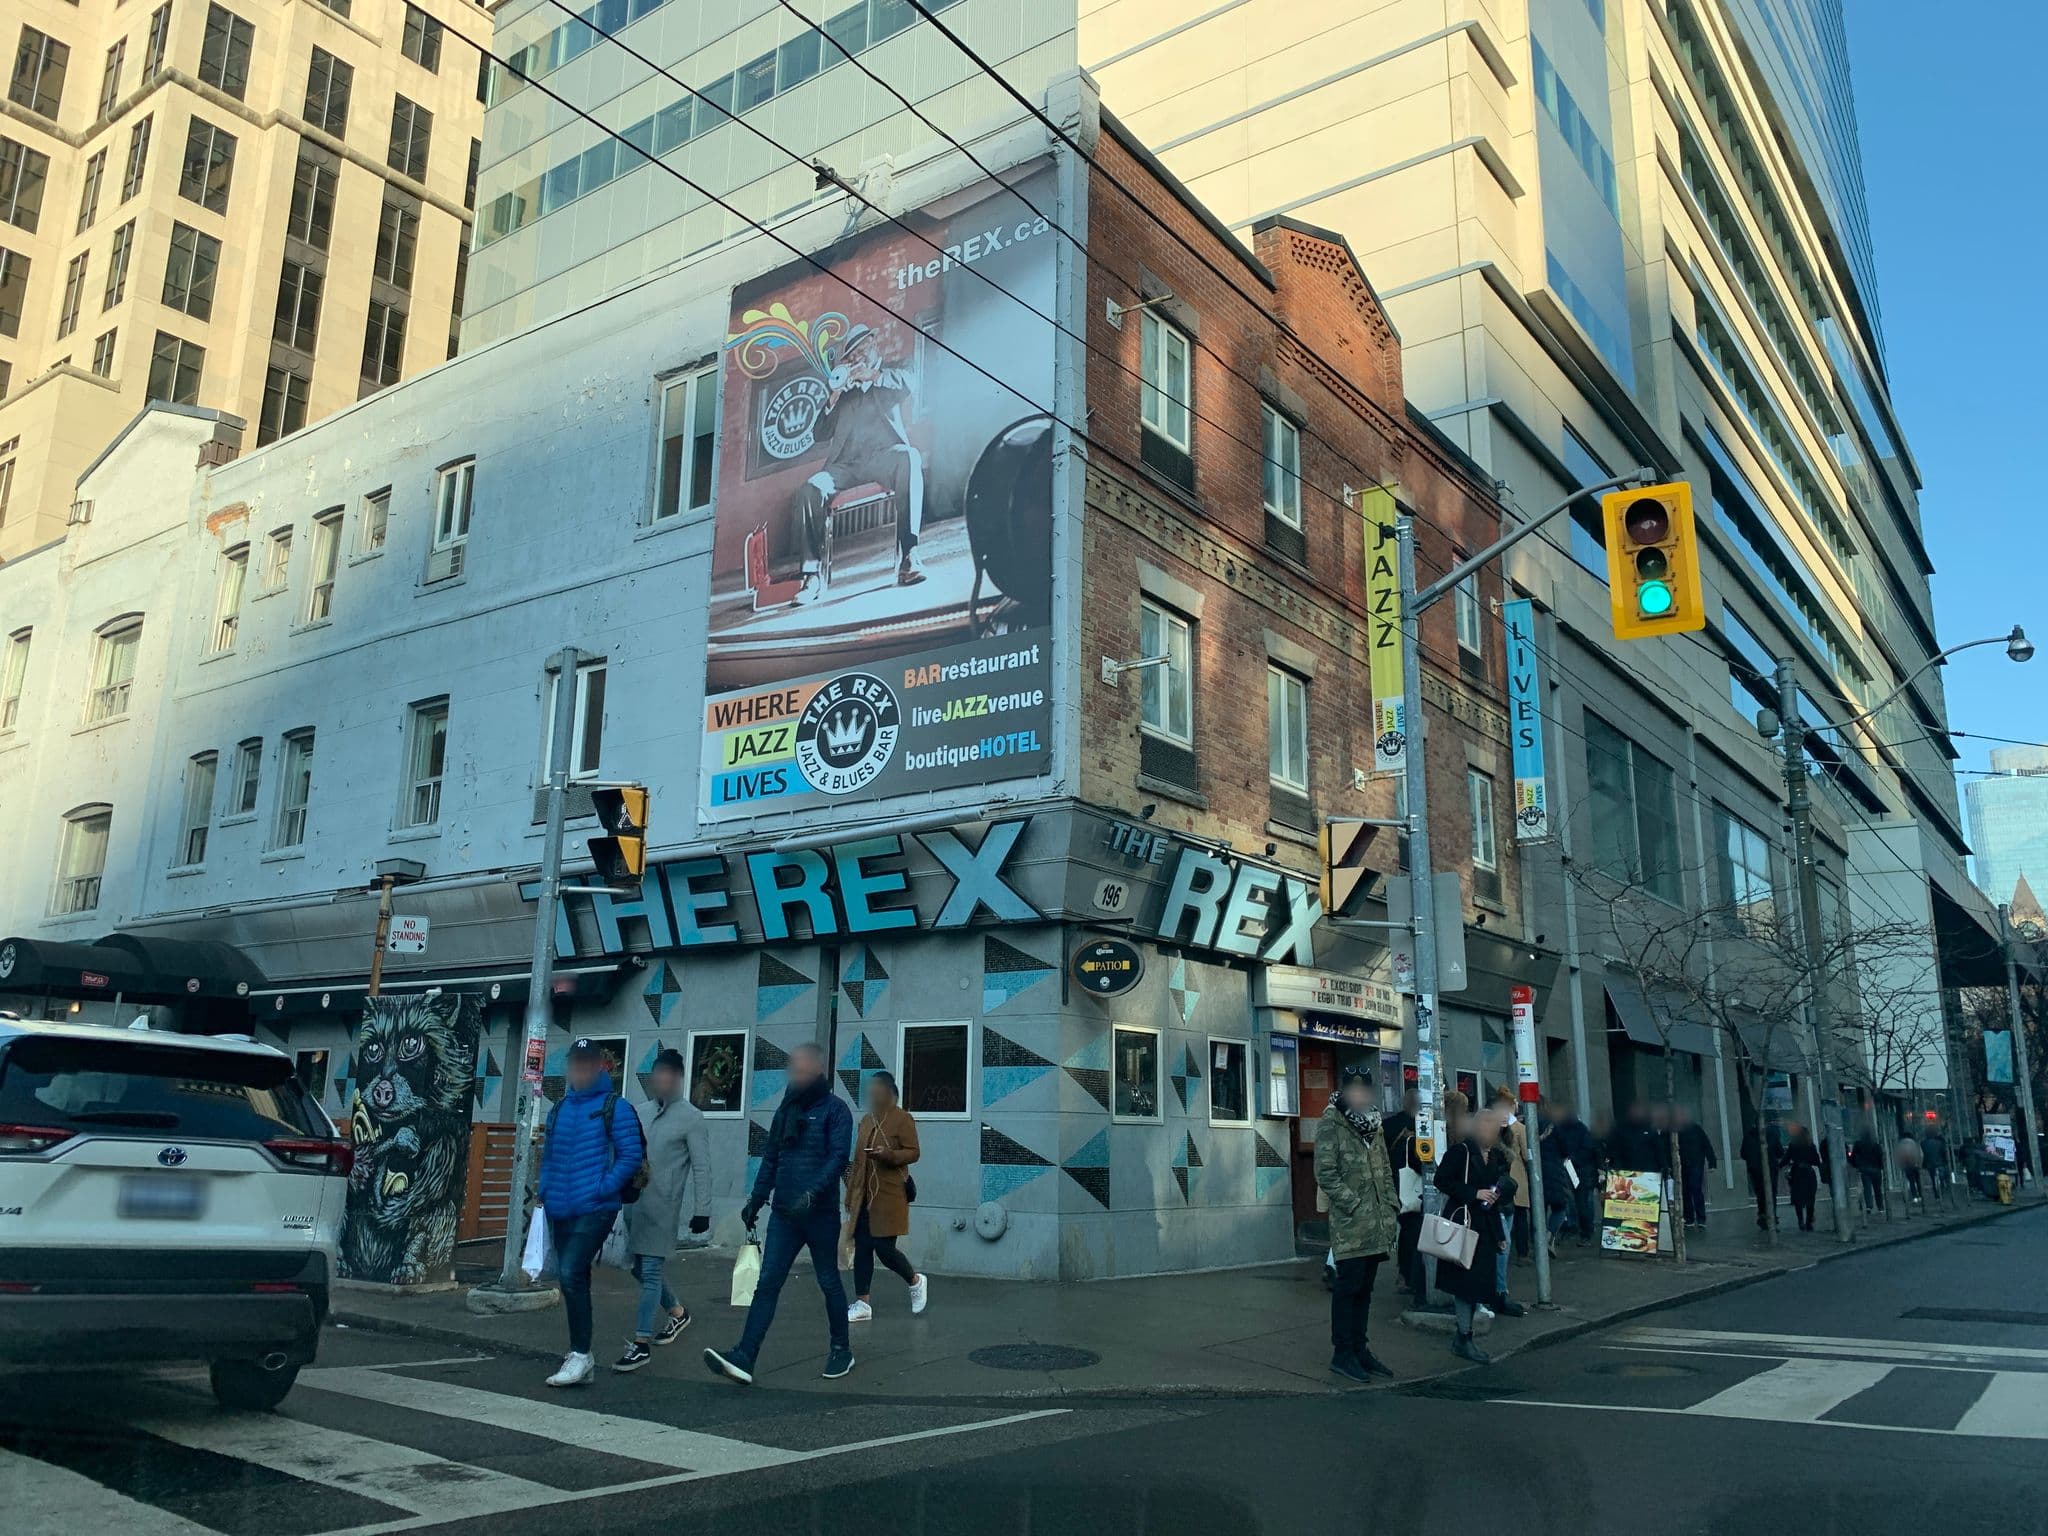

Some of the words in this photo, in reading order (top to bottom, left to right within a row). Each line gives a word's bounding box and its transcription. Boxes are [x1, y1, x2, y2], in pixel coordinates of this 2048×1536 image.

[896, 213, 1050, 290] theREX.ca
[768, 387, 793, 420] THE
[797, 381, 826, 404] REX
[784, 433, 812, 455] BLUES
[1371, 521, 1395, 648] JAZZ
[802, 682, 843, 725] THE
[851, 678, 893, 715] REX
[1512, 621, 1535, 748] LIVES
[714, 689, 800, 728] WHERE
[1386, 710, 1395, 729] JAZZ
[728, 728, 788, 765] JAZZ
[800, 744, 822, 779] JAZZ
[820, 771, 829, 786] &
[832, 762, 875, 789] BLUES
[873, 730, 894, 762] BAR
[722, 768, 788, 801] LIVES
[747, 817, 1047, 940] REX
[1102, 883, 1122, 908] 196
[1112, 821, 1169, 865] THE
[1158, 847, 1323, 967] REX
[391, 931, 426, 942] STANDING
[403, 920, 416, 930] NO
[1095, 960, 1122, 971] PATIO
